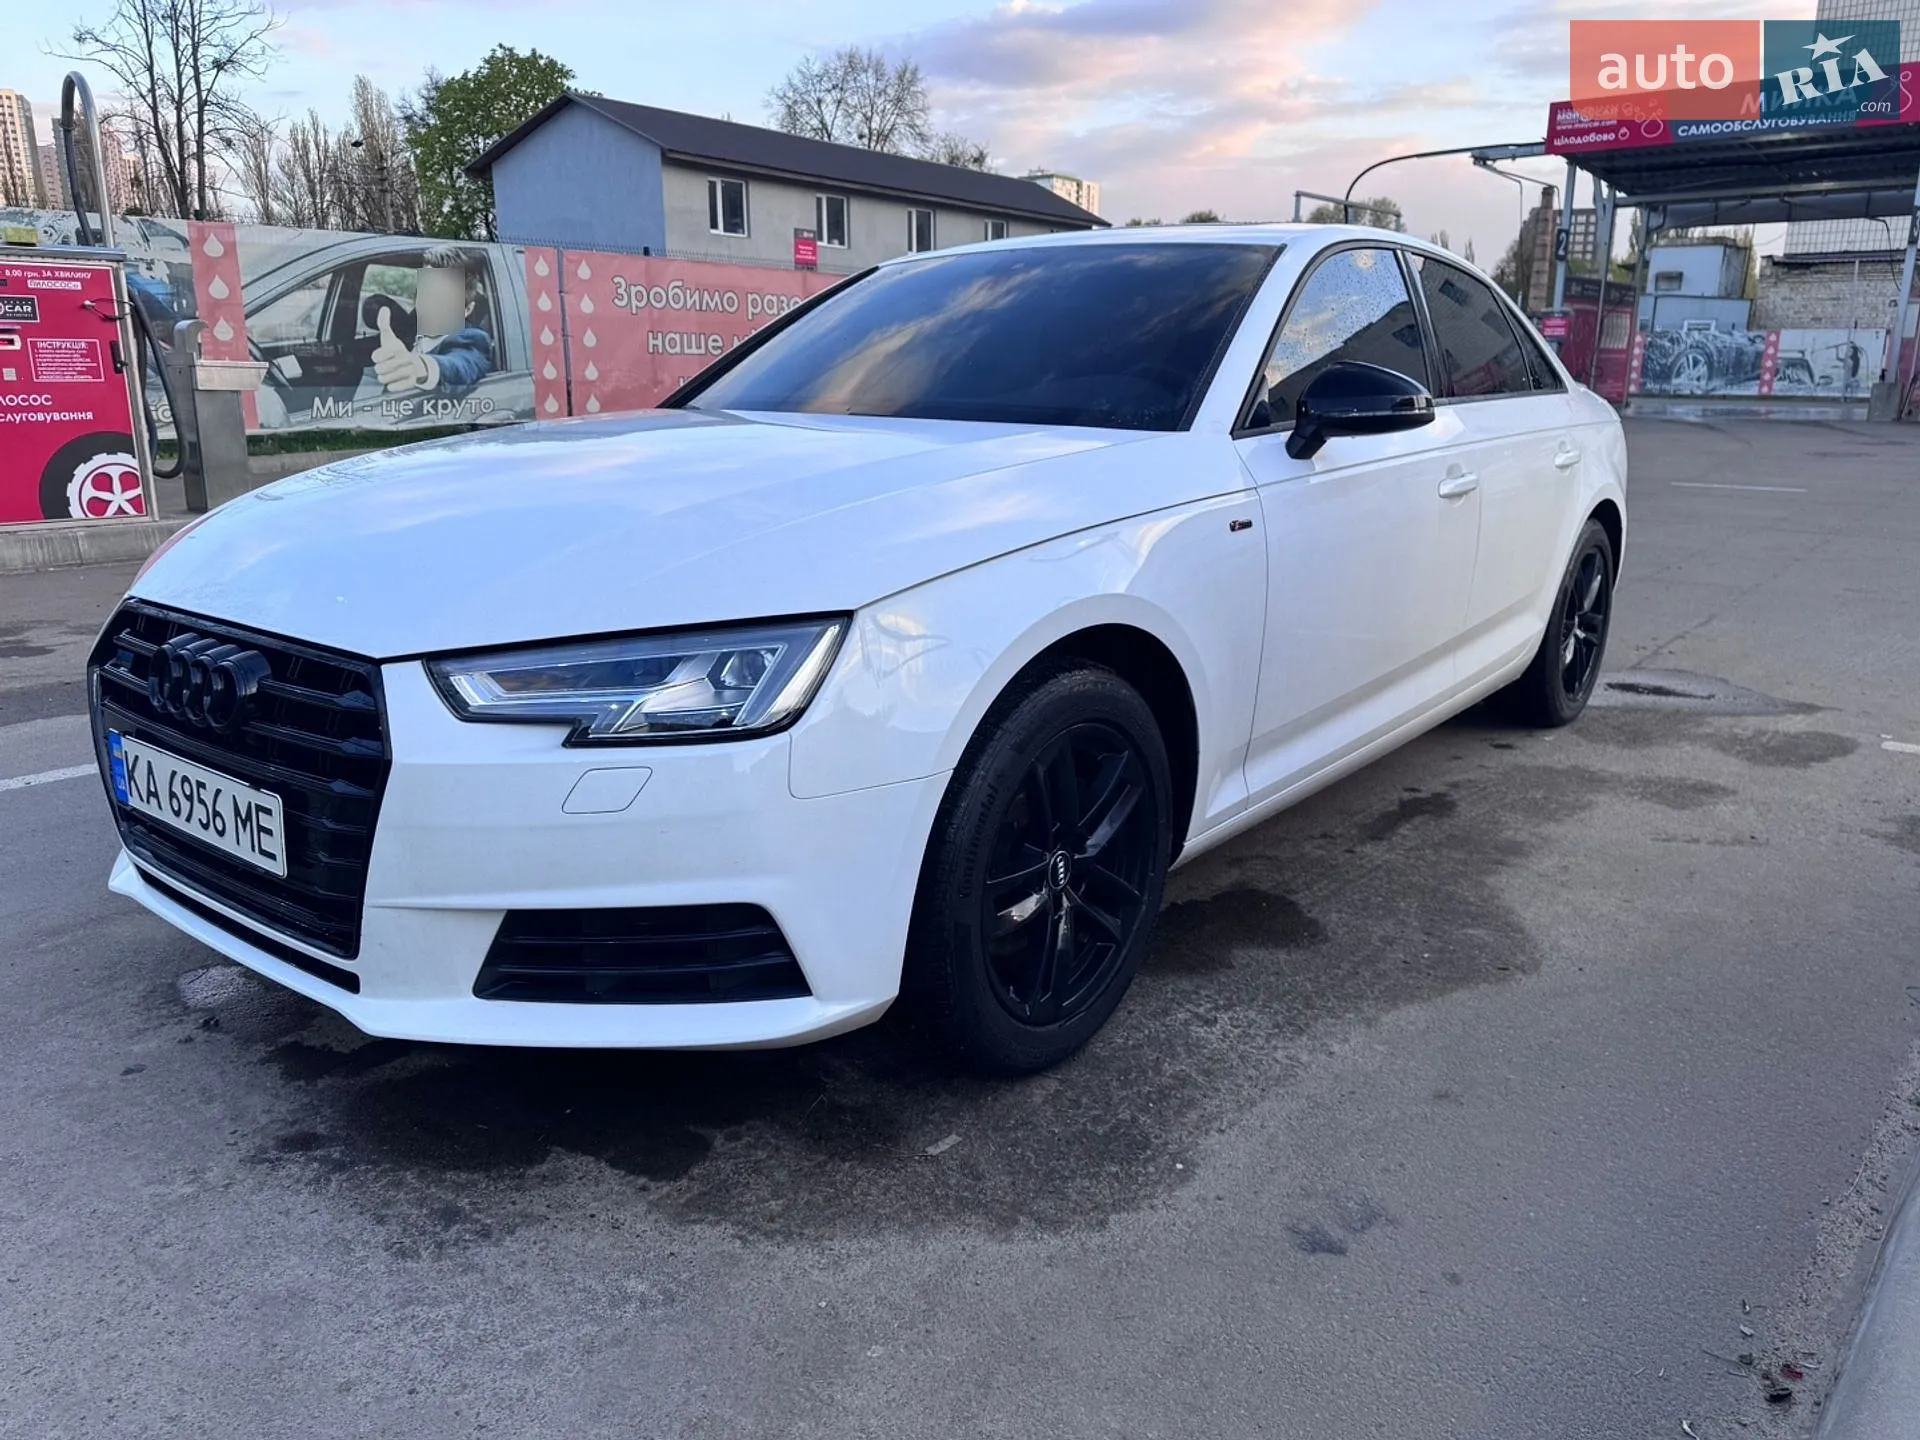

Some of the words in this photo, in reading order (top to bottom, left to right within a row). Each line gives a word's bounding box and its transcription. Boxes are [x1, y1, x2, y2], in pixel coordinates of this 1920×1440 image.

[1558, 231, 1567, 256] 2
[611, 275, 739, 315] Зробимо
[647, 331, 725, 355] наше
[311, 396, 353, 419] Ми
[381, 399, 414, 421] це
[422, 397, 496, 420] круто
[124, 750, 163, 811] KA
[168, 769, 226, 838] 6956
[232, 794, 278, 862] ME
